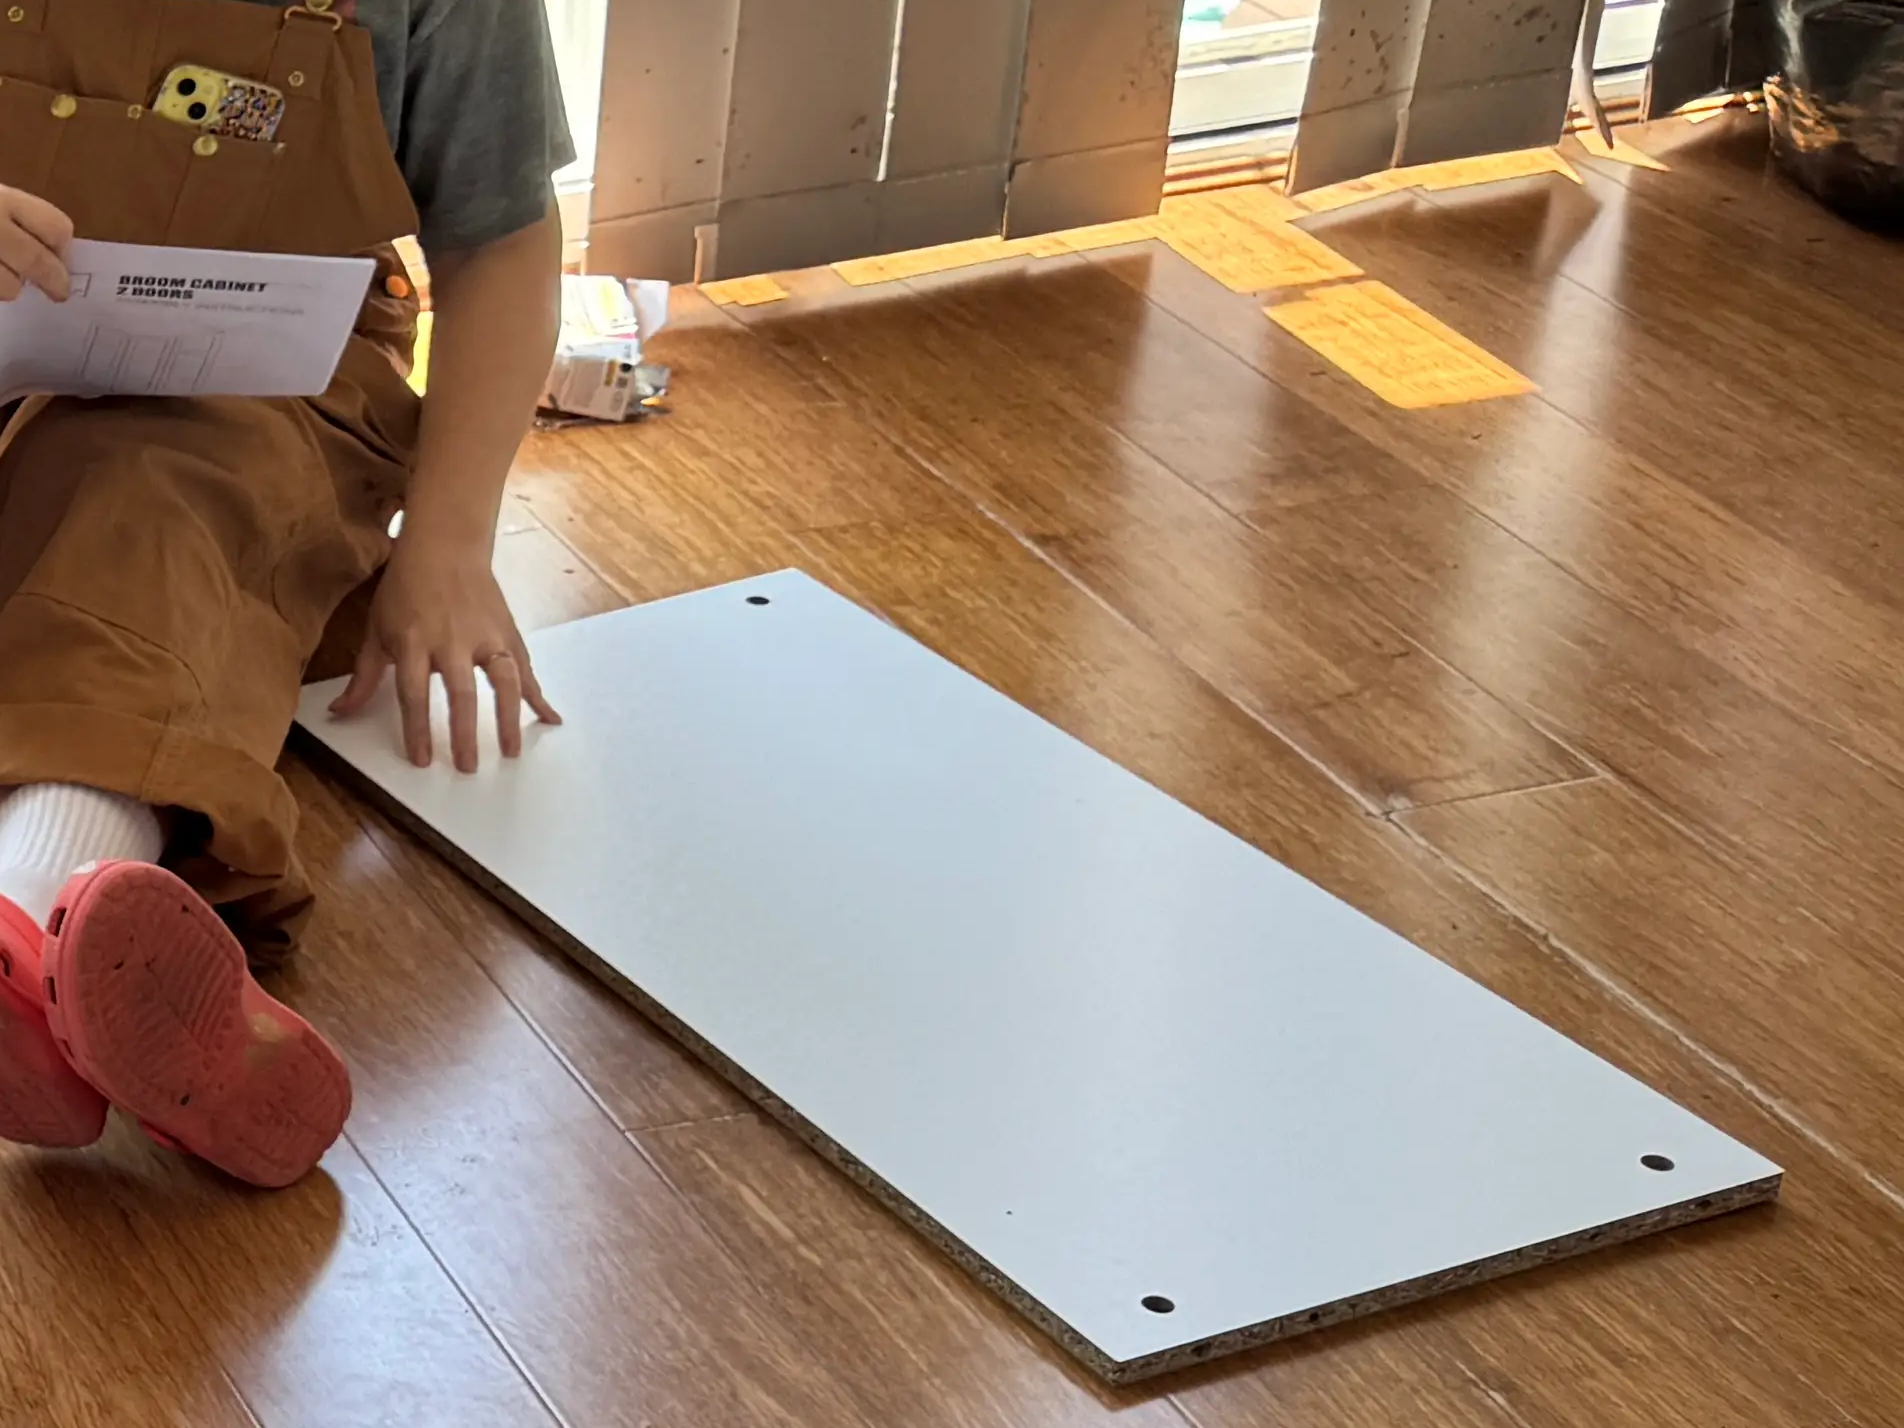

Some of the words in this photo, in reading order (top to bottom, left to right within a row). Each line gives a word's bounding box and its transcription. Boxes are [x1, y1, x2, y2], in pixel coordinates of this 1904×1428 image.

[118, 274, 187, 290] BROOM
[190, 277, 268, 293] CABINET
[131, 287, 194, 300] DOORS
